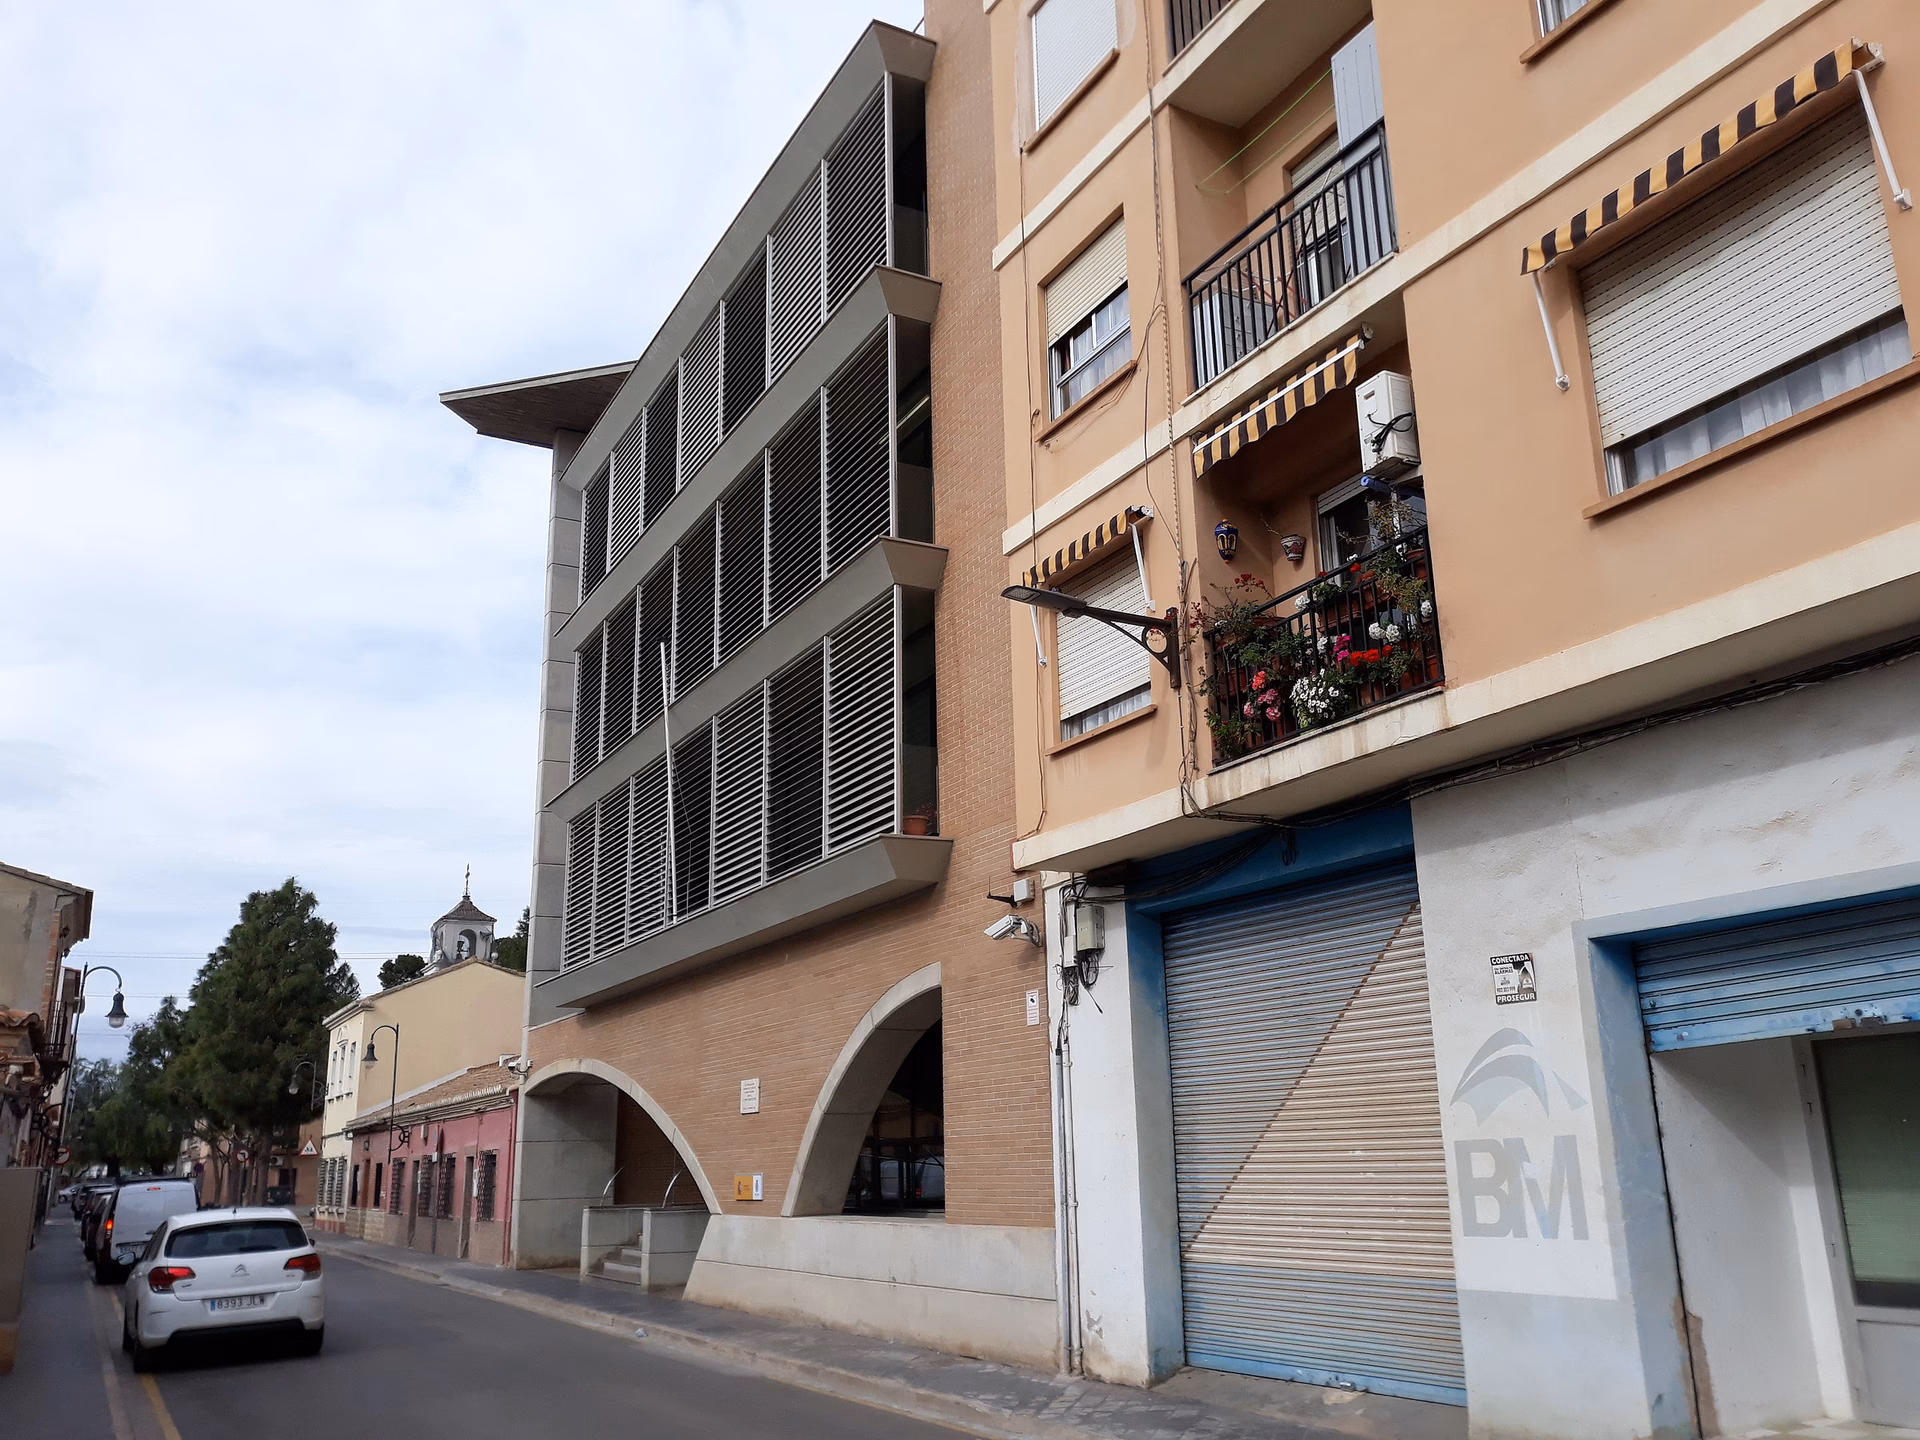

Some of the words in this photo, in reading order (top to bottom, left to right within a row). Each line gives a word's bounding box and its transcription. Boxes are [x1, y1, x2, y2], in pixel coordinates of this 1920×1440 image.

[1491, 954, 1530, 964] CONECTADA
[1497, 993, 1535, 1003] PROSEGUR
[1454, 1135, 1589, 1240] BM
